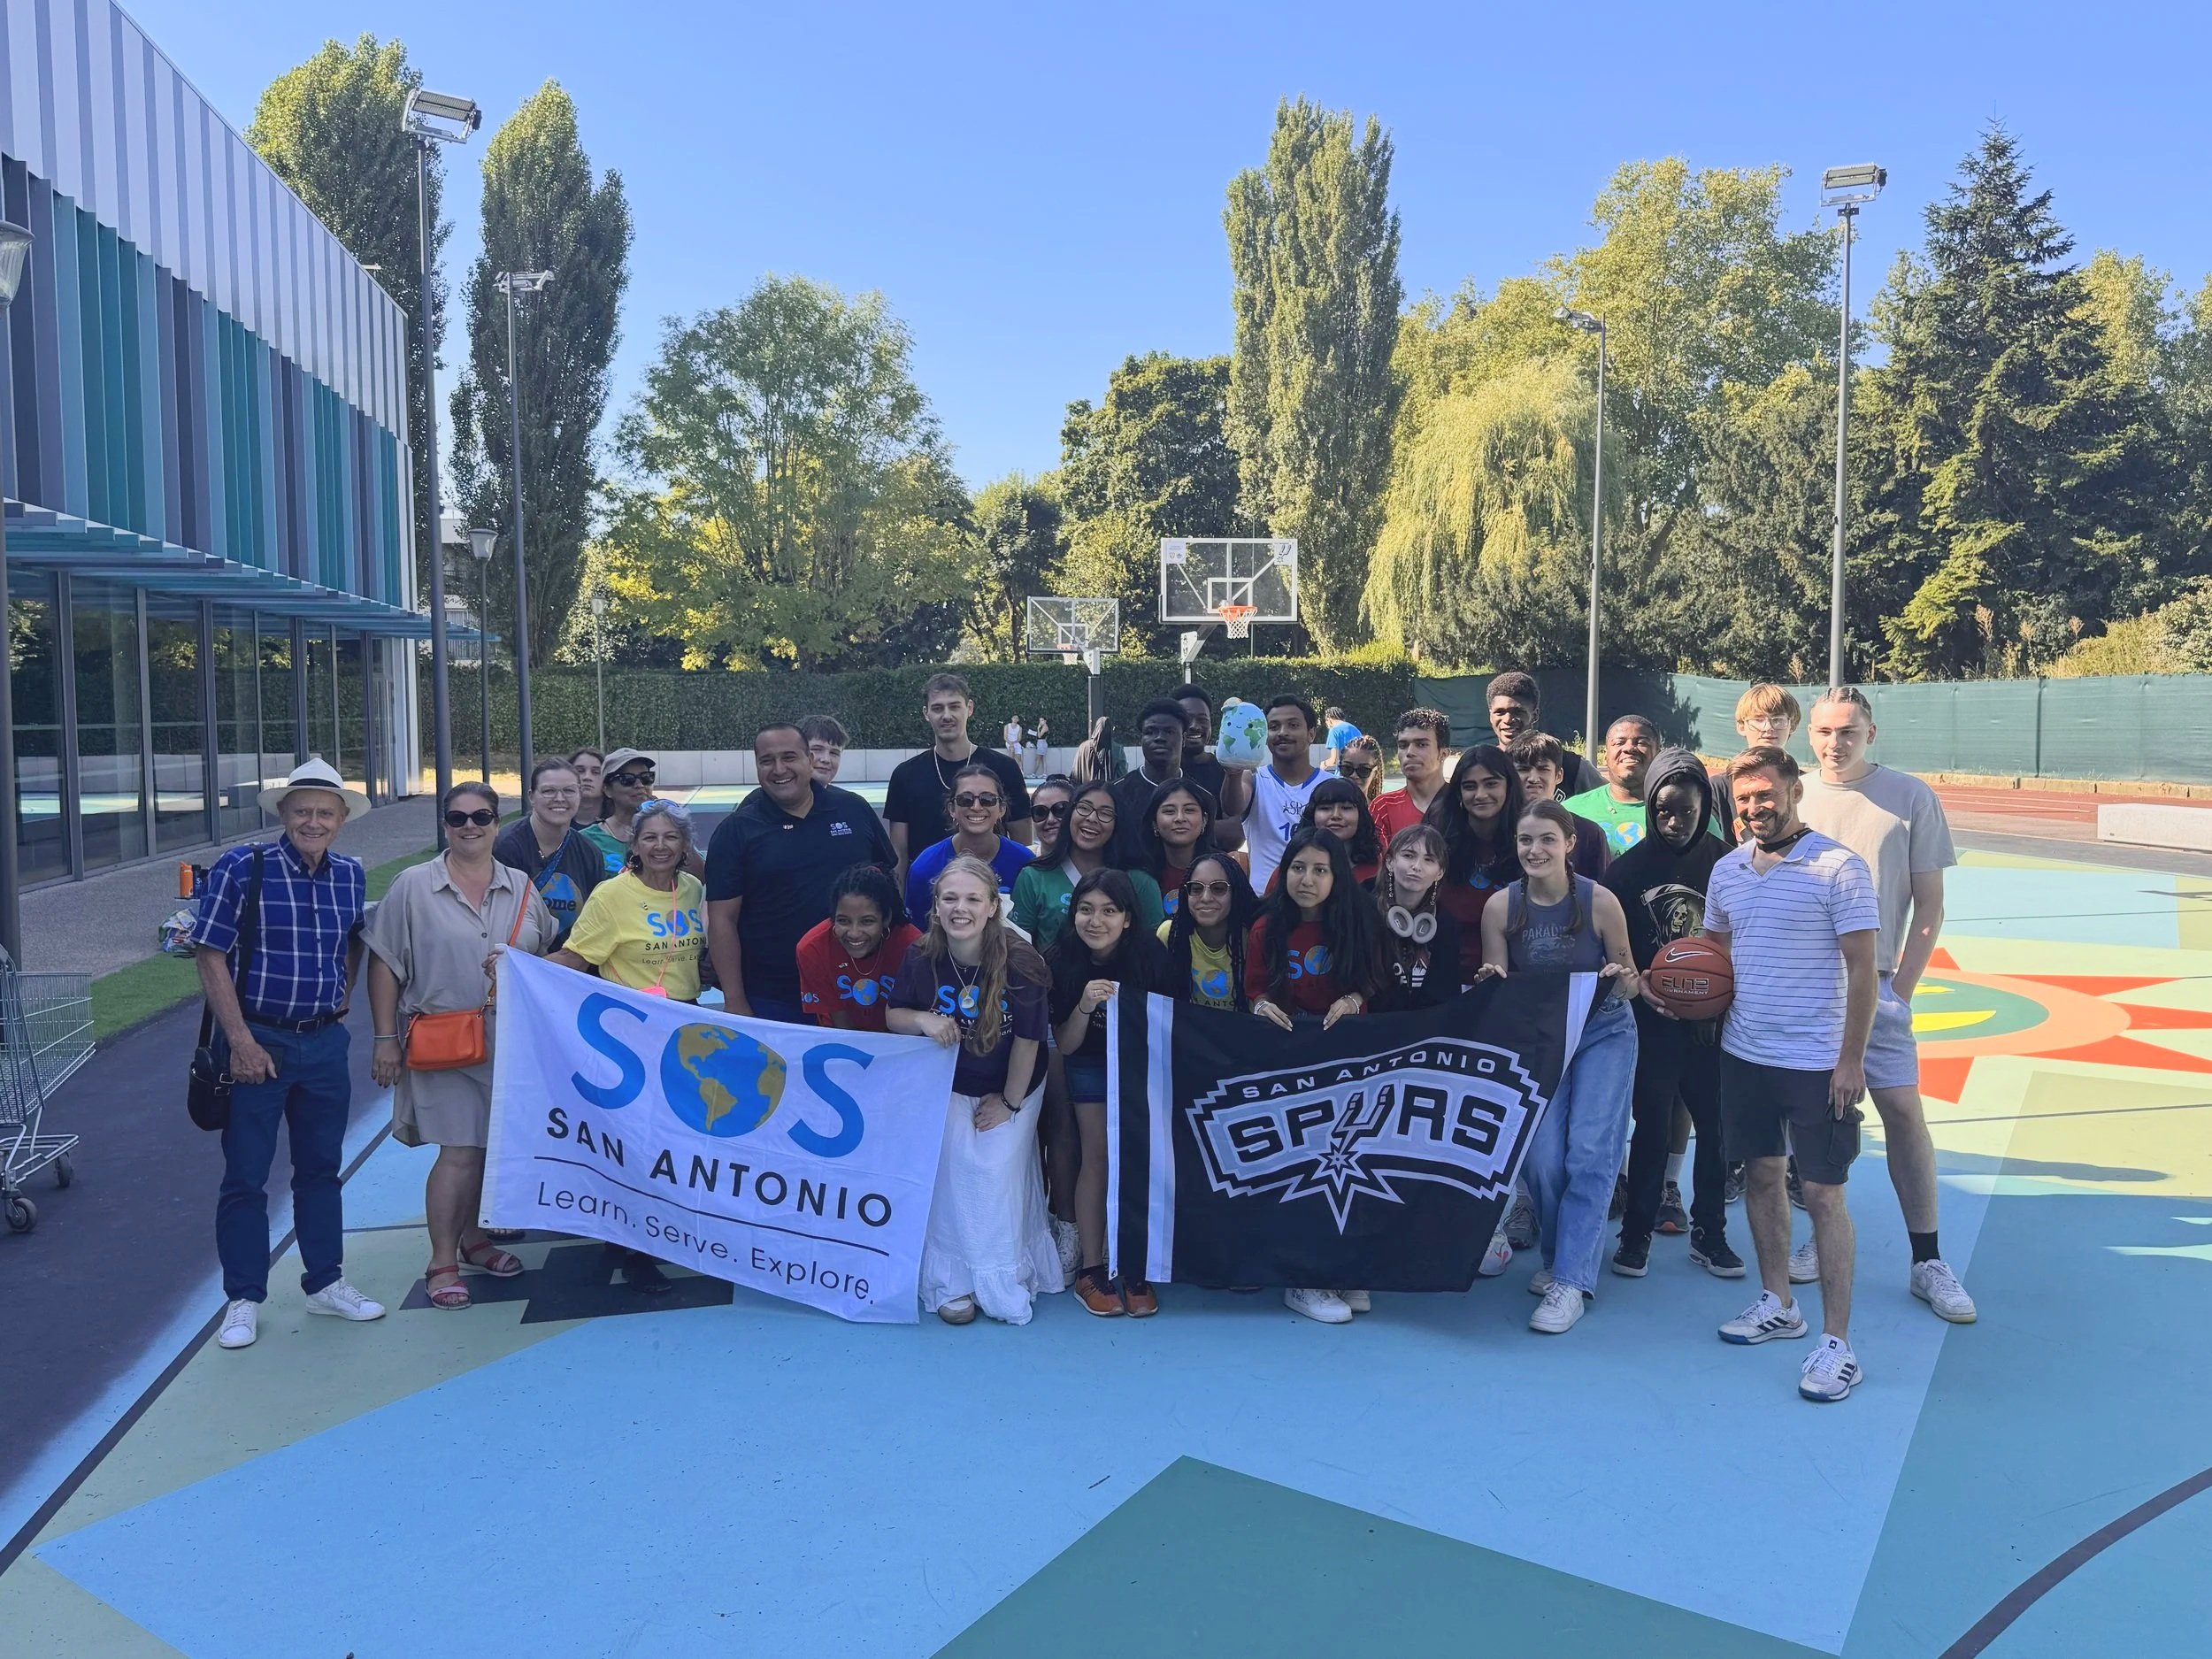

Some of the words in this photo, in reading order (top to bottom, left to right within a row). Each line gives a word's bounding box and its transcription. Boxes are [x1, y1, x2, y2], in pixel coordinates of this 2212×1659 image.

[542, 896, 577, 911] ome
[647, 909, 704, 937] SOS
[645, 941, 668, 951] SAN
[572, 992, 875, 1158] SOS
[1242, 1076, 1315, 1099] SAN
[1335, 1050, 1496, 1082] ANTONIO
[1227, 1083, 1508, 1164] SPURS
[547, 1107, 625, 1168] SAN
[649, 1148, 892, 1227] ANTONIO
[537, 1181, 636, 1228] Learn.
[645, 1216, 738, 1263] Serve.
[751, 1247, 874, 1305] Explore.
